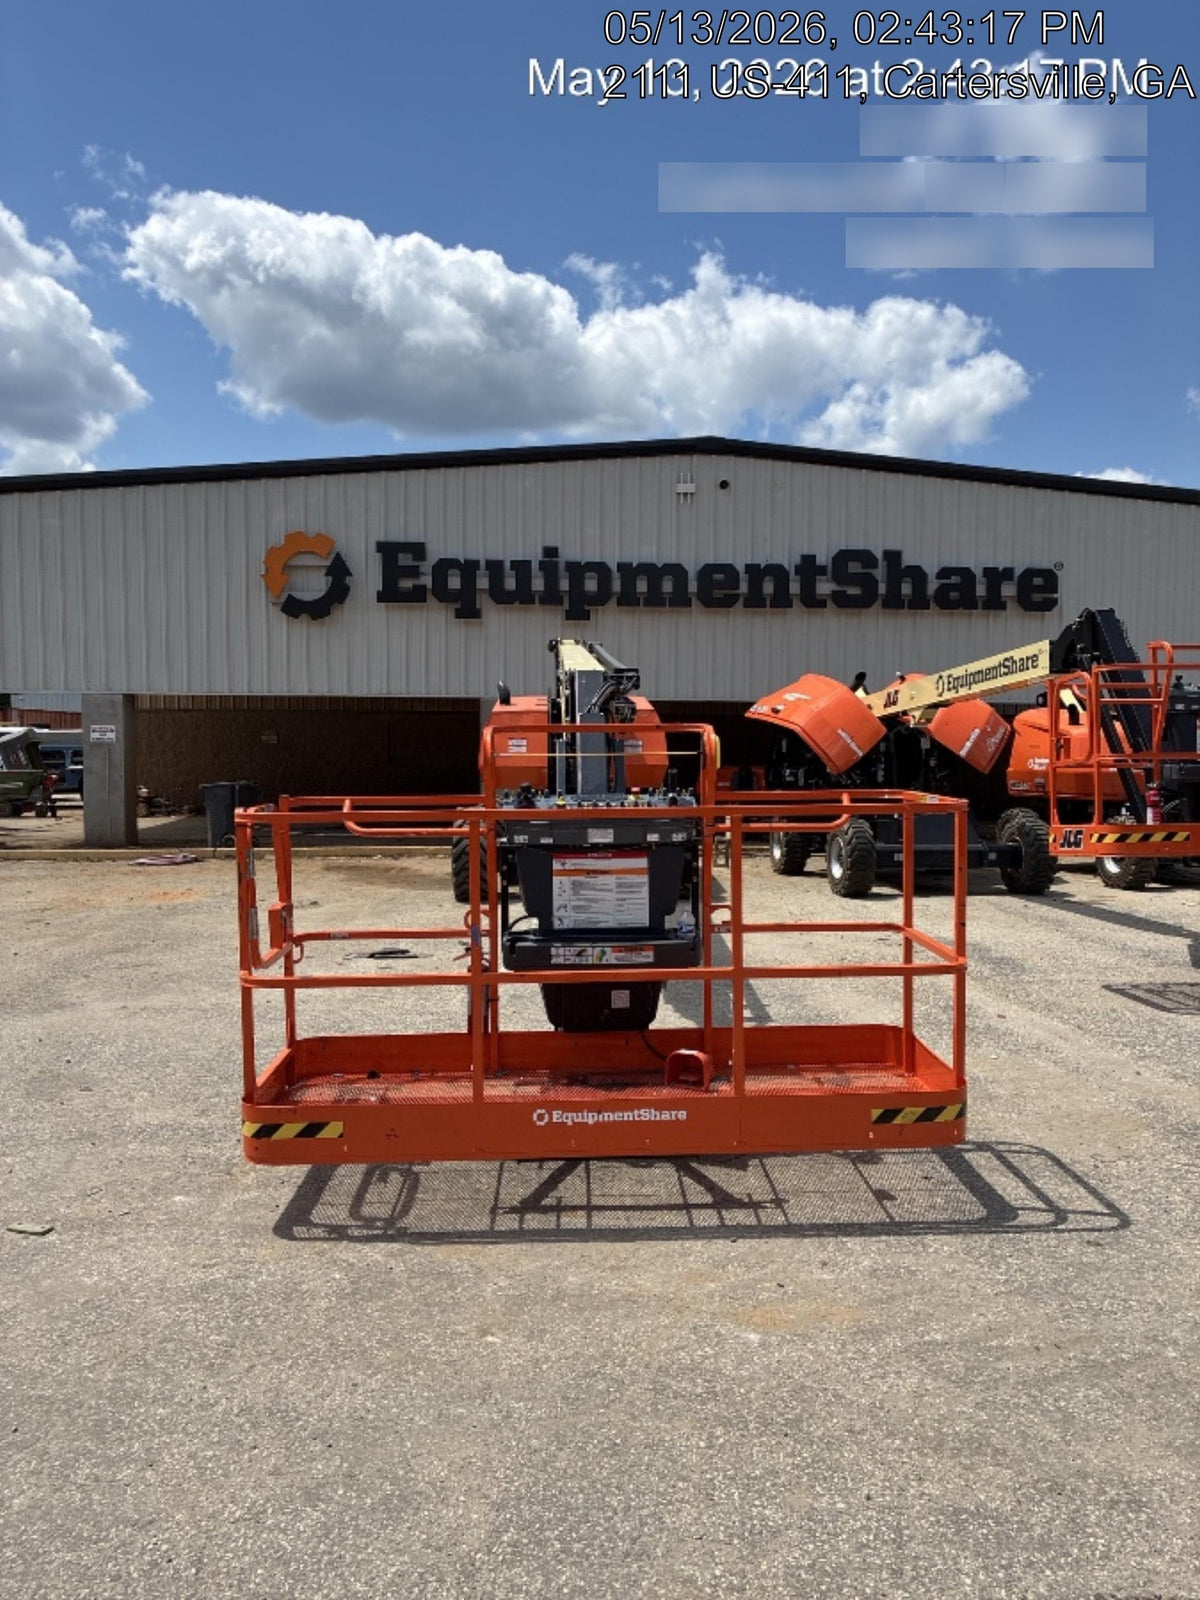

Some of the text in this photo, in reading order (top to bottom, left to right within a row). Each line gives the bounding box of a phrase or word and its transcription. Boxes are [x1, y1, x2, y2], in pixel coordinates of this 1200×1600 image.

[946, 653, 1039, 693] EquipmentShare
[883, 689, 900, 709] JLG
[1059, 828, 1085, 850] JLG
[551, 1108, 687, 1125] EquipmentShare
